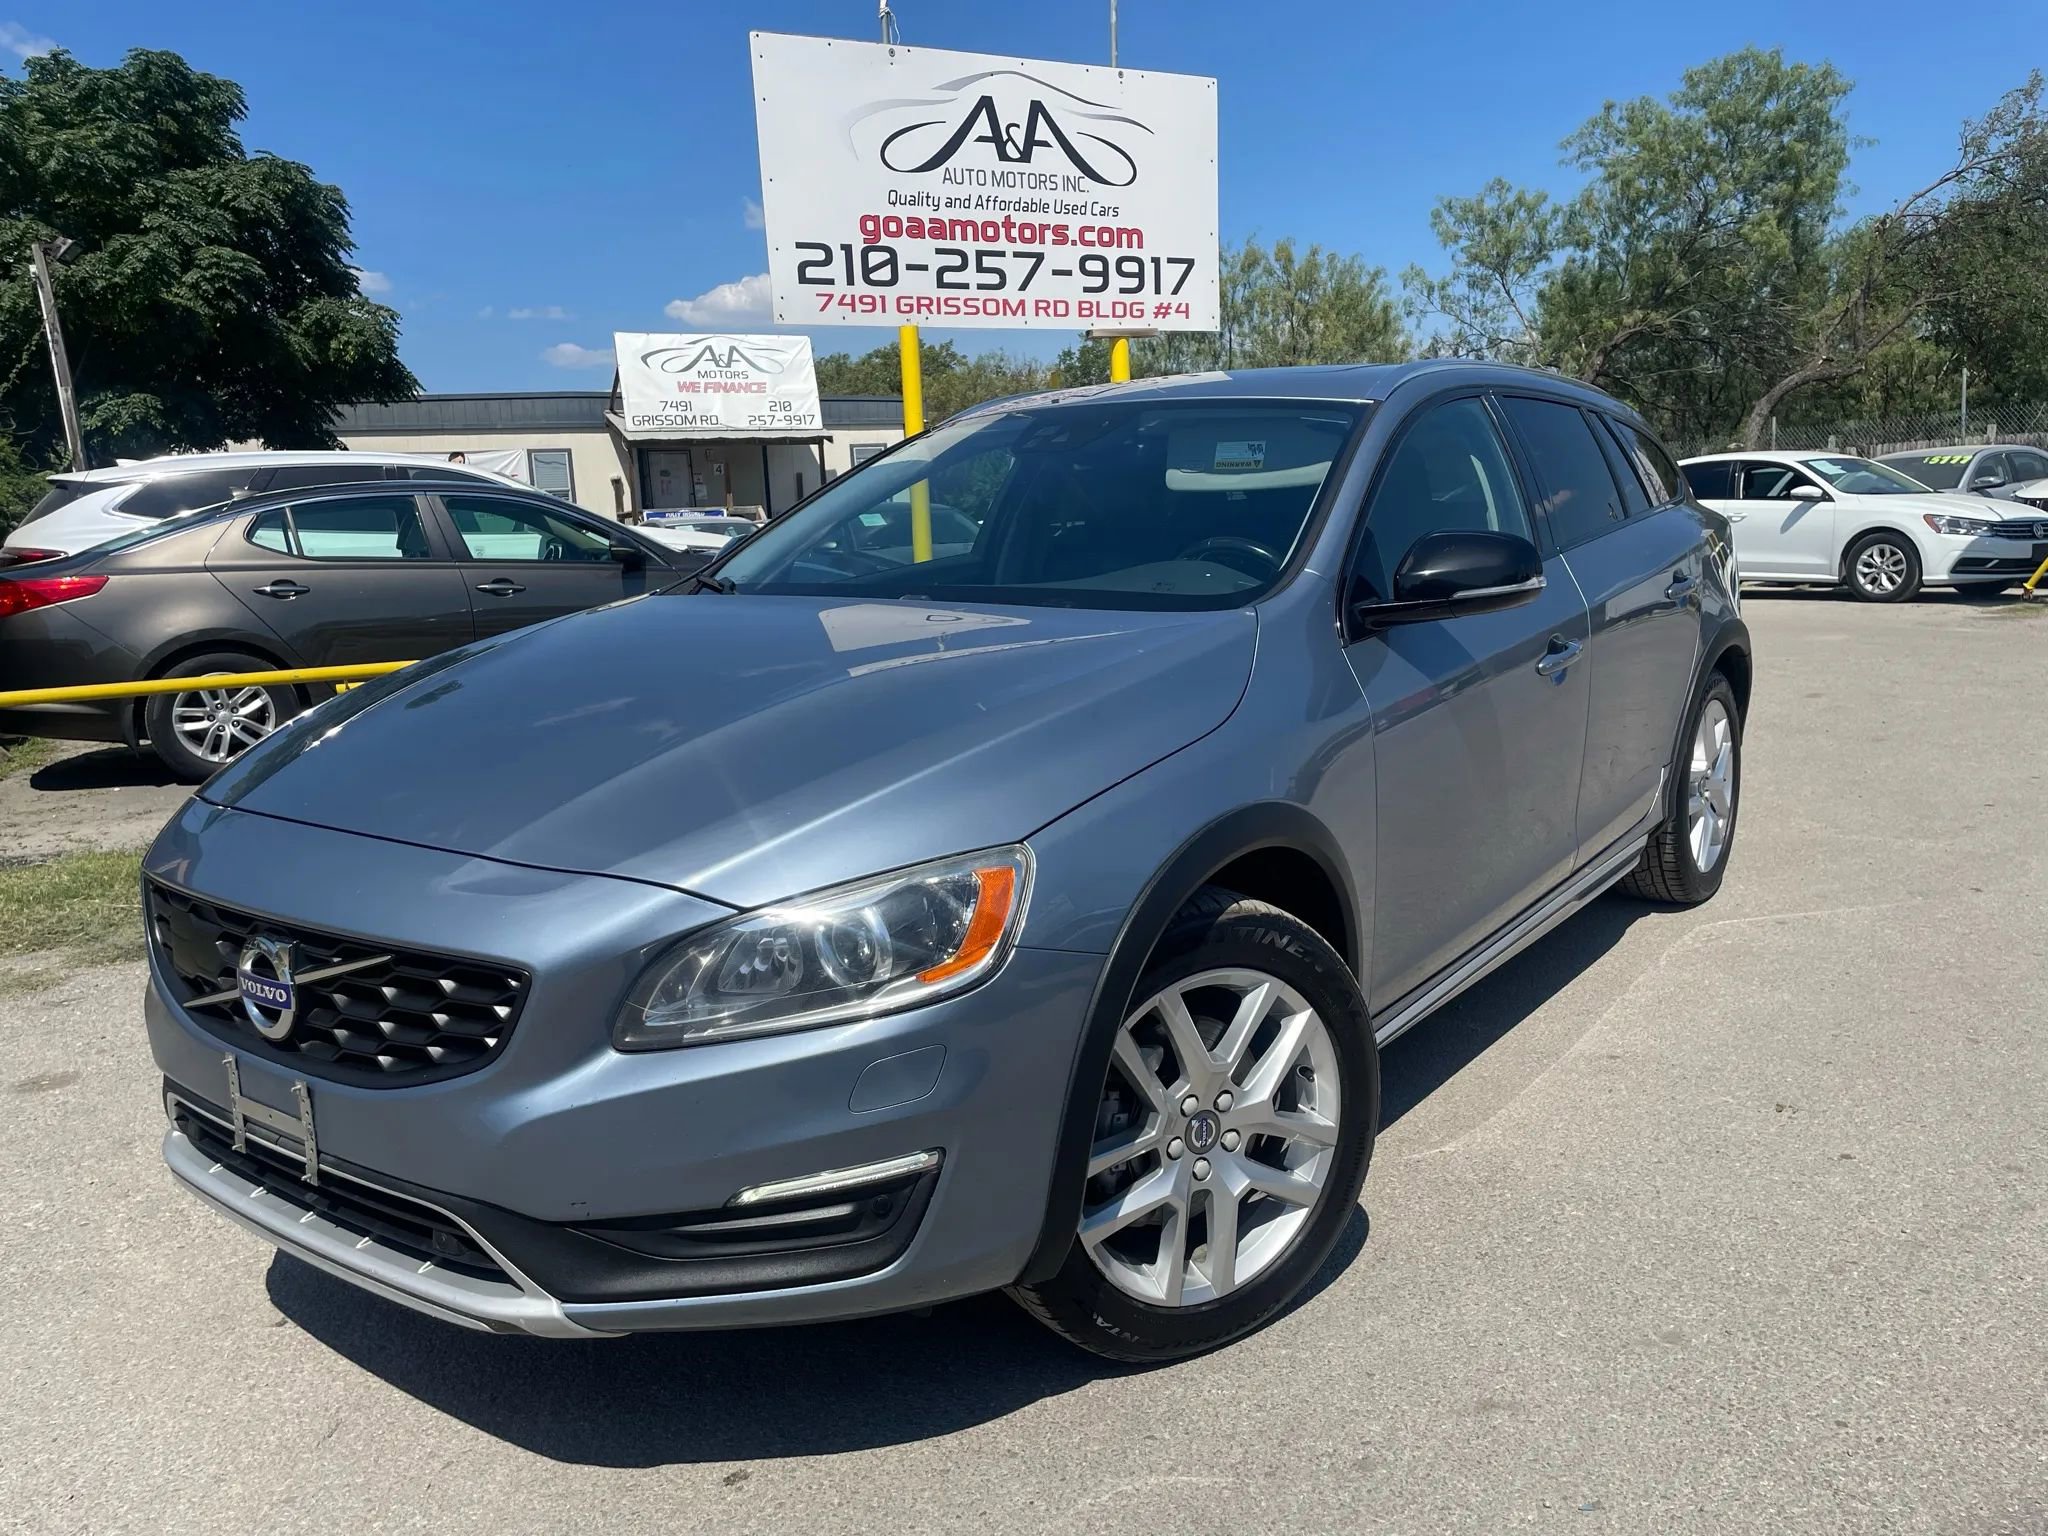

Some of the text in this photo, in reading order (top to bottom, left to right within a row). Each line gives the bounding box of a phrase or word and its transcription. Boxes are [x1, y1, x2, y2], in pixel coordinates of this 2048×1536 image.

[942, 166, 1090, 194] AUTO MOTORS INC.
[887, 189, 1120, 218] Quality and Affordable Used Cars
[859, 213, 1144, 249] goaamotors.com
[795, 241, 1195, 295] 210-257-9917
[816, 293, 1190, 320] 7491 GRISSOM RD BLDG #4
[697, 370, 749, 380] MOTORS
[677, 381, 767, 394] WE FINANCE
[659, 400, 693, 412] 7491
[768, 400, 792, 412] 210
[632, 414, 697, 427] GRISSOM
[748, 414, 815, 426] 257-9917
[715, 464, 722, 474] 4
[239, 976, 287, 1003] VOLVO
